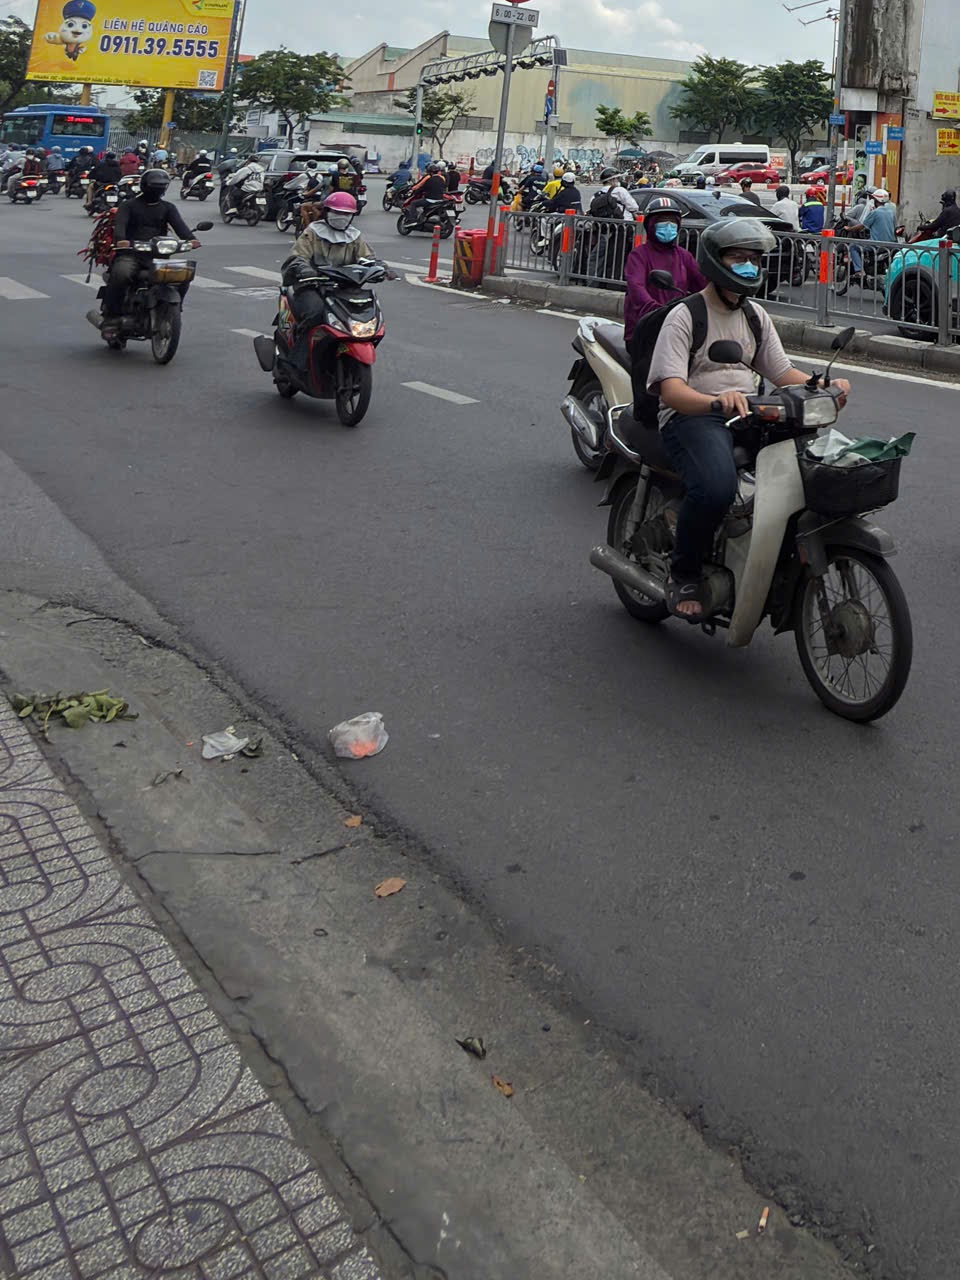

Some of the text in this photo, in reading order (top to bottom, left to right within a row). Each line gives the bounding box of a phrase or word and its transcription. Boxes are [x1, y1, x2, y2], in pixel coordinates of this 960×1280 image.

[103, 18, 208, 35] LIÊN HỆ QUẢNG CÁO
[99, 34, 219, 58] 0911.39.5555
